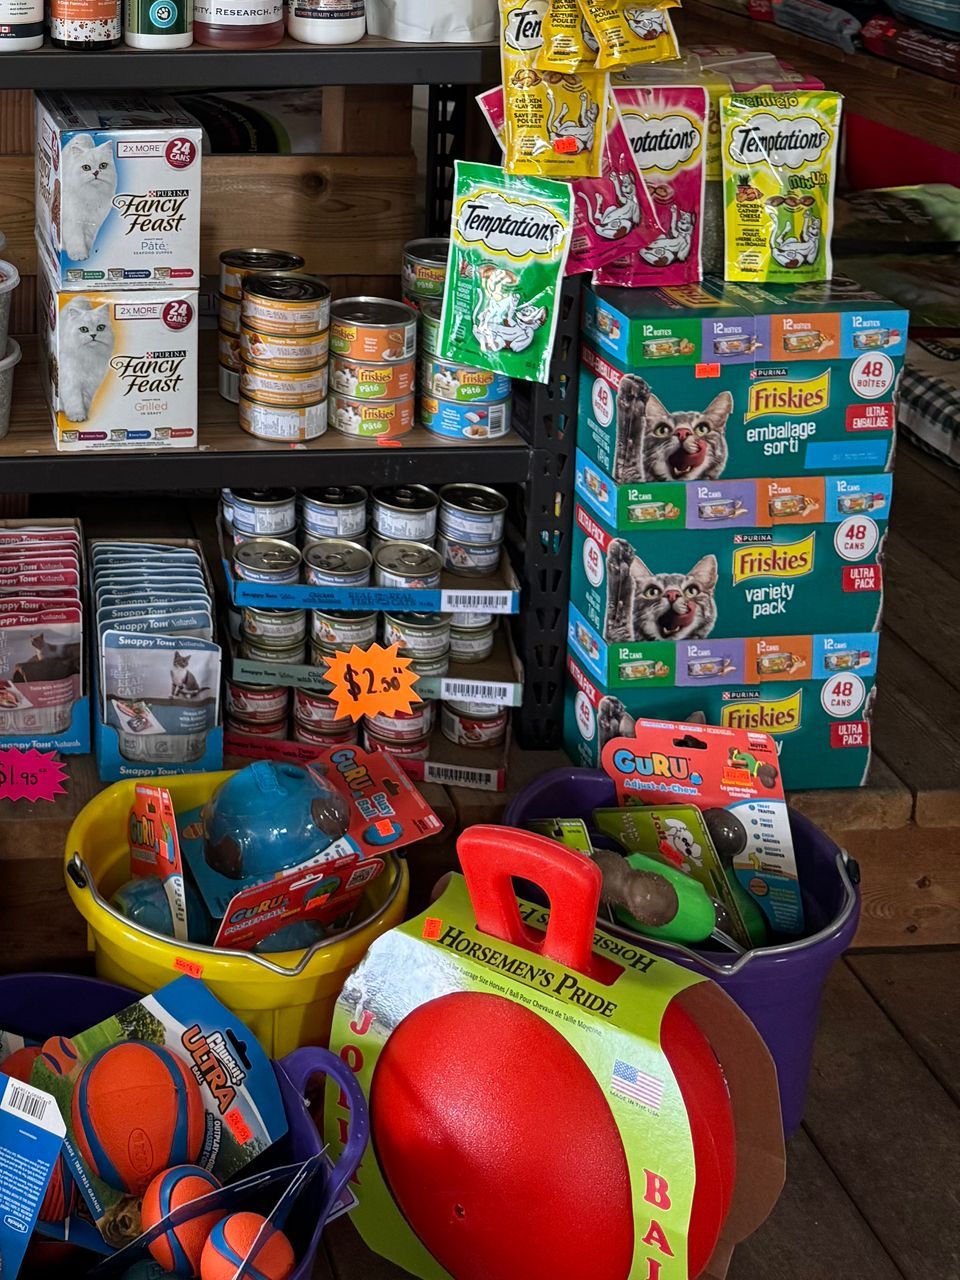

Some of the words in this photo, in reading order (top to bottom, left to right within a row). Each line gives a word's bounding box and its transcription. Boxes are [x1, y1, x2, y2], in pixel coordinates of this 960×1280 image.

[215, 6, 272, 17] RESEARCH.
[122, 145, 136, 154] 2X
[136, 144, 161, 153] MORE
[173, 140, 191, 155] 24
[737, 127, 825, 158] Temptations
[170, 152, 192, 163] CANS
[155, 189, 189, 198] PURINA
[112, 193, 186, 217] Fancy
[124, 214, 182, 236] Feast
[463, 204, 560, 243] Temptations
[140, 239, 166, 252] Pâté
[119, 307, 133, 316] 2X
[133, 306, 158, 315] MORE
[170, 302, 187, 317] 24
[166, 314, 188, 324] CANS
[152, 351, 187, 359] PURINA
[110, 355, 184, 379] Fancy
[757, 368, 787, 377] PURINA
[861, 361, 883, 378] 48
[359, 371, 392, 383] Friskies
[461, 373, 494, 384] Friskies
[123, 375, 179, 397] Feast
[753, 386, 825, 411] Friskies
[134, 401, 168, 412] Grilled
[865, 406, 889, 418] ULTRA-
[362, 408, 395, 421] Friskies
[852, 415, 890, 429] EMBALLAGE
[746, 421, 817, 443] emballage
[763, 437, 800, 456] sorti
[742, 534, 773, 543] PURINA
[844, 524, 867, 542] 48
[843, 541, 866, 551] CANS
[739, 551, 809, 575] Friskies
[850, 567, 876, 580] ULTRA
[854, 577, 876, 590] PACK
[745, 582, 795, 604] variety
[752, 598, 787, 619] pack
[118, 636, 155, 647] Snappy
[156, 638, 176, 647] Tom
[730, 690, 761, 700] PURINA
[831, 680, 853, 698] 48
[830, 697, 852, 708] CANS
[728, 706, 796, 731] Friskies
[838, 723, 863, 737] ULTRA
[842, 733, 863, 746] PACK
[623, 779, 699, 796] Adjust-A-Chew
[437, 925, 556, 989] HORSEMEN'S
[553, 972, 618, 1019] PRIDE
[205, 1030, 247, 1086] Chuckit!
[181, 1023, 237, 1116] ULTRA
